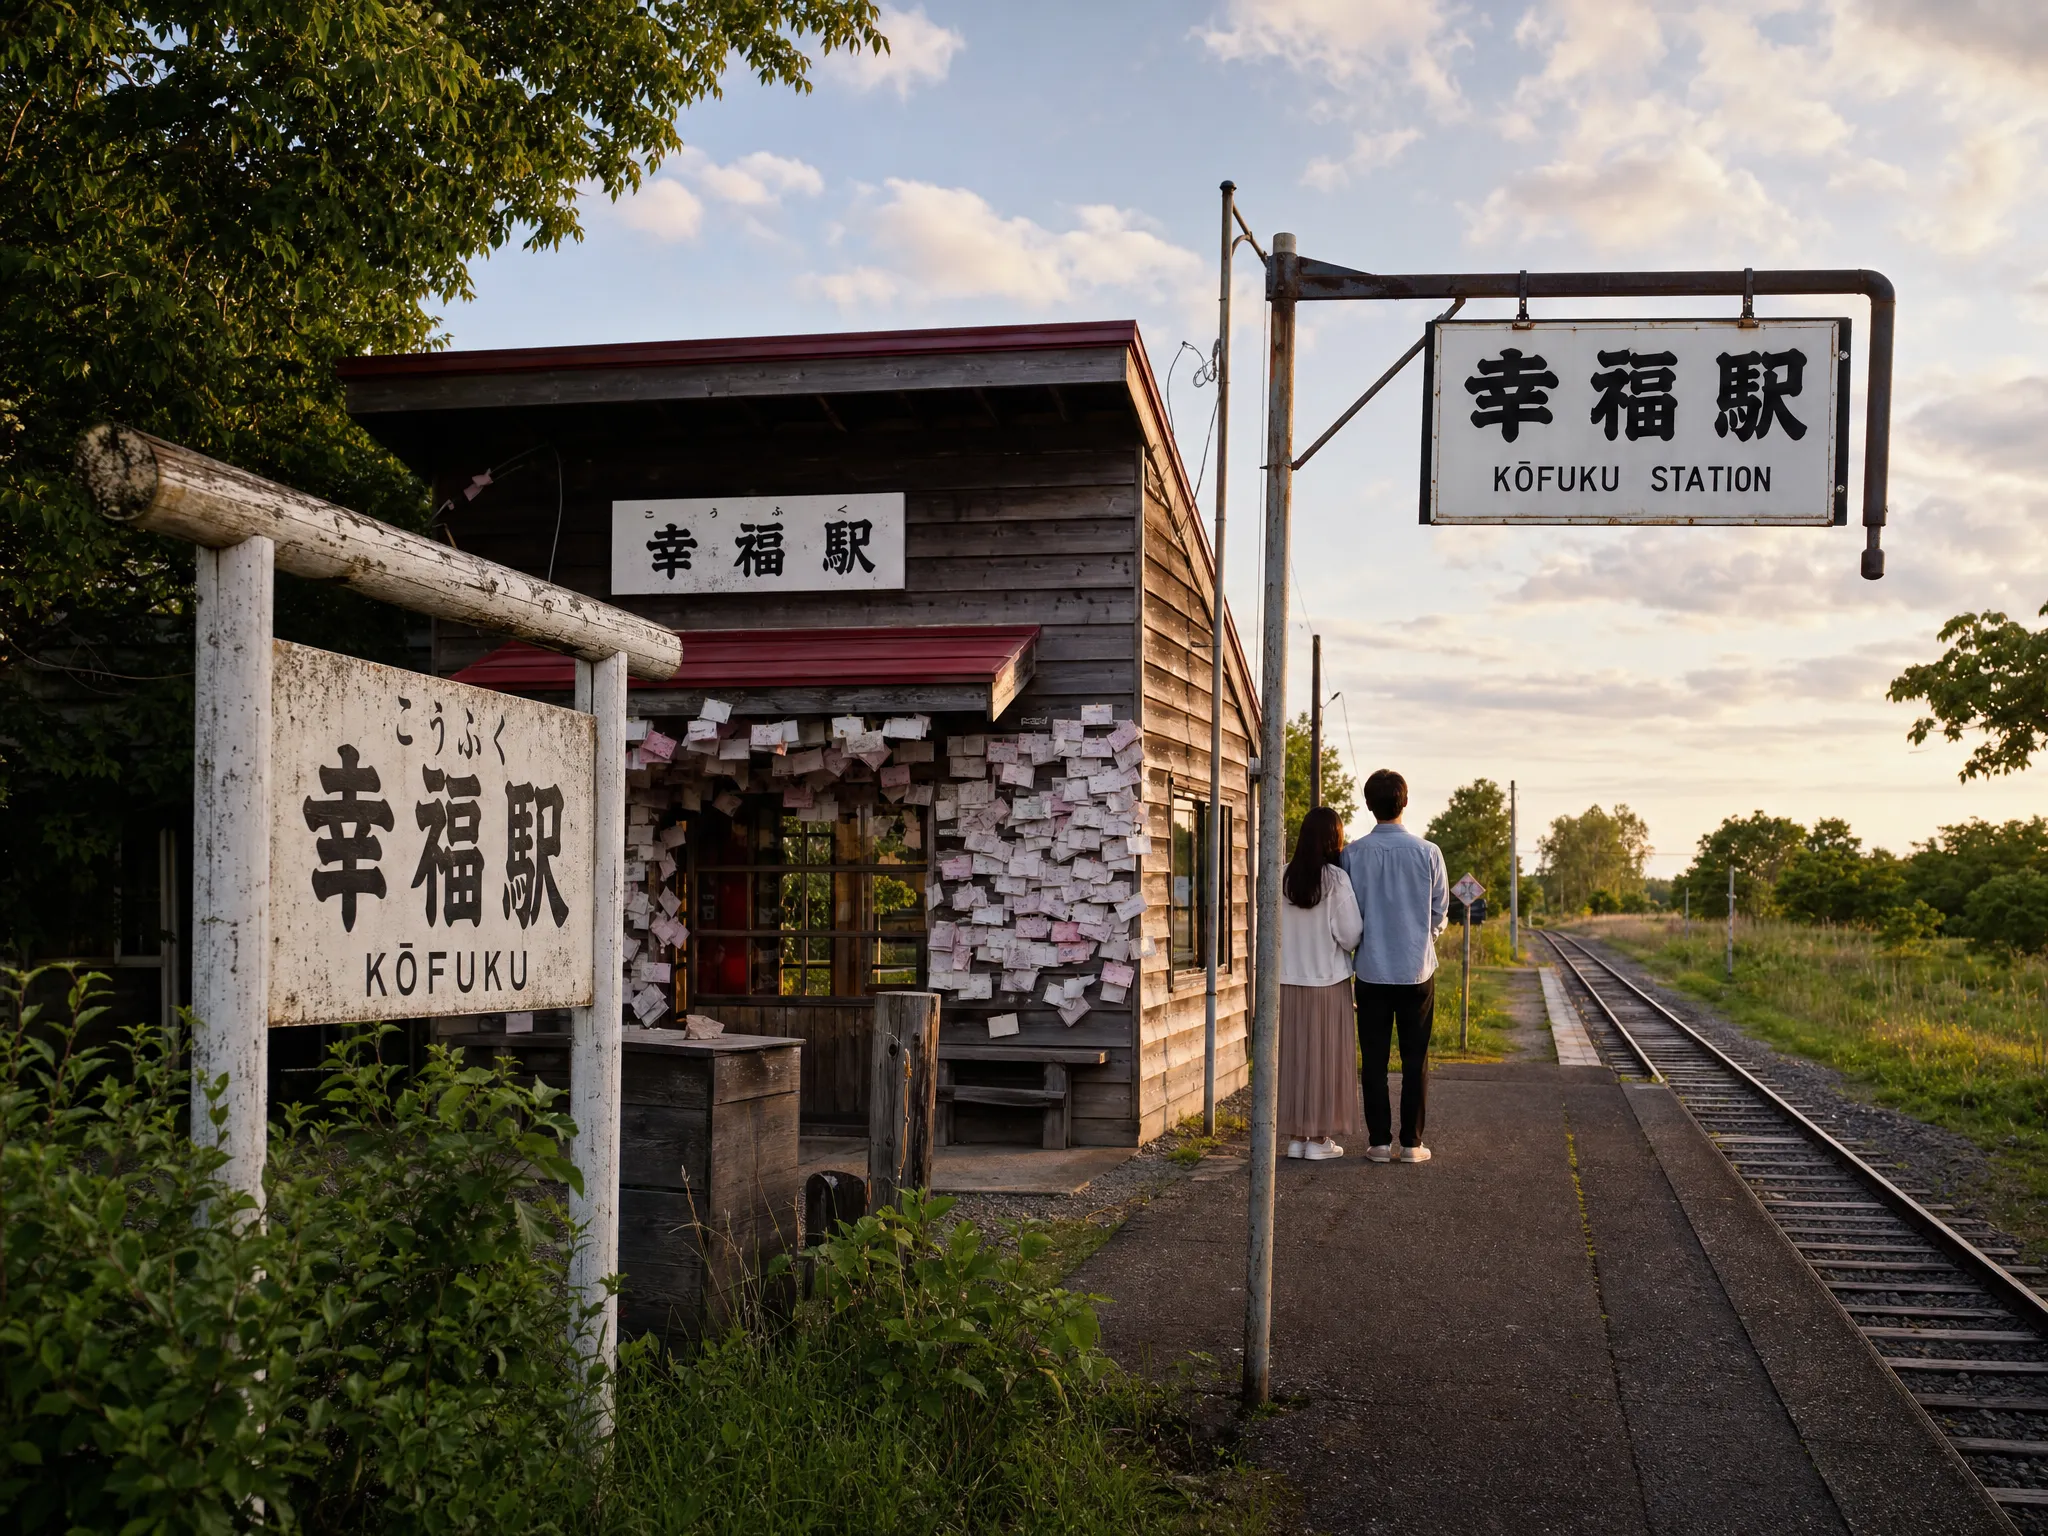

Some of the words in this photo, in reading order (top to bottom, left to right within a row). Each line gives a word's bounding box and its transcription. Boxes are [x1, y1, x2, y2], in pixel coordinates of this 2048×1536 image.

[1464, 347, 1808, 443] 幸福駅
[1493, 461, 1620, 492] KŌFUKU
[1650, 465, 1772, 492] STATION
[643, 503, 848, 519] こうふく
[646, 518, 876, 580] 幸福駅
[395, 695, 506, 766] こうふく
[302, 743, 570, 933] 幸福駅
[366, 942, 528, 997] KŌFUKU
